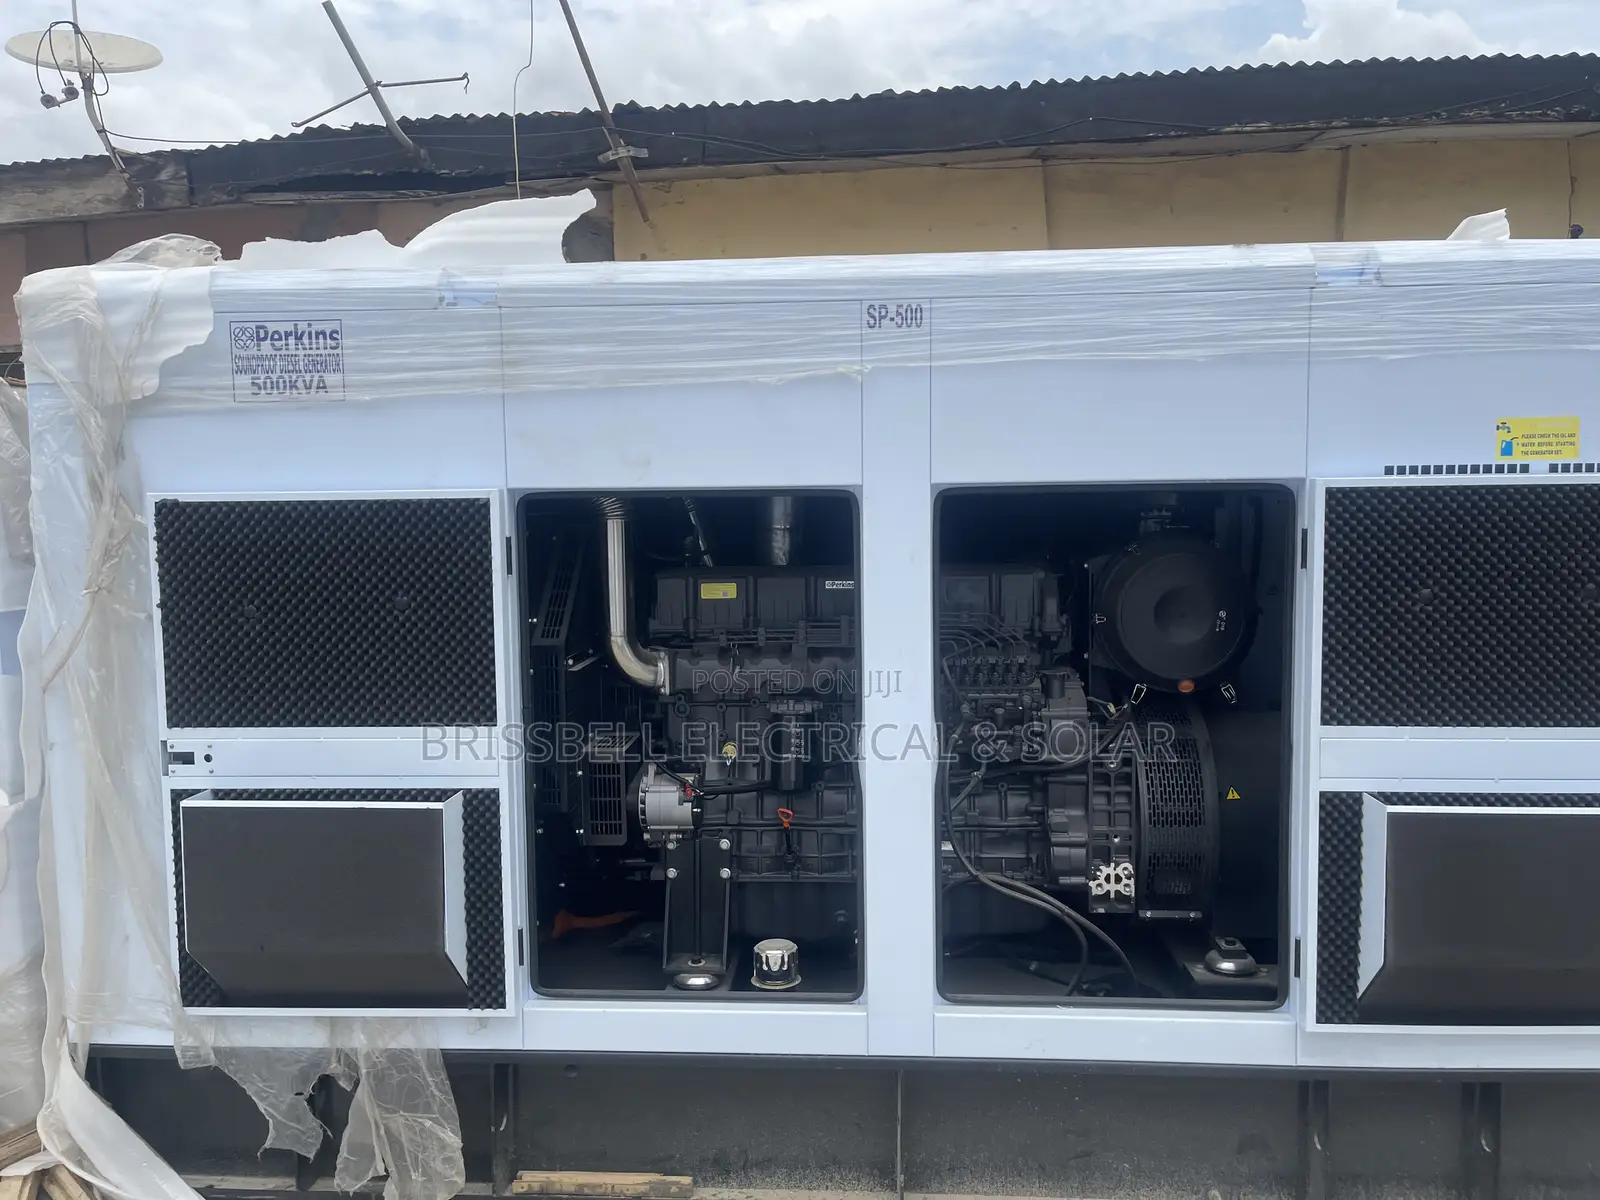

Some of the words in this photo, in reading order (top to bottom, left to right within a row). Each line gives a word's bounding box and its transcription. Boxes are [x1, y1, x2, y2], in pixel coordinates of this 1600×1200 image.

[866, 303, 923, 329] SP-500
[255, 322, 340, 352] Perkins
[234, 354, 278, 375] SOUNDPROOF
[279, 353, 302, 375] DIESEL
[303, 352, 341, 374] GENERATOR
[250, 375, 329, 396] 500KVA
